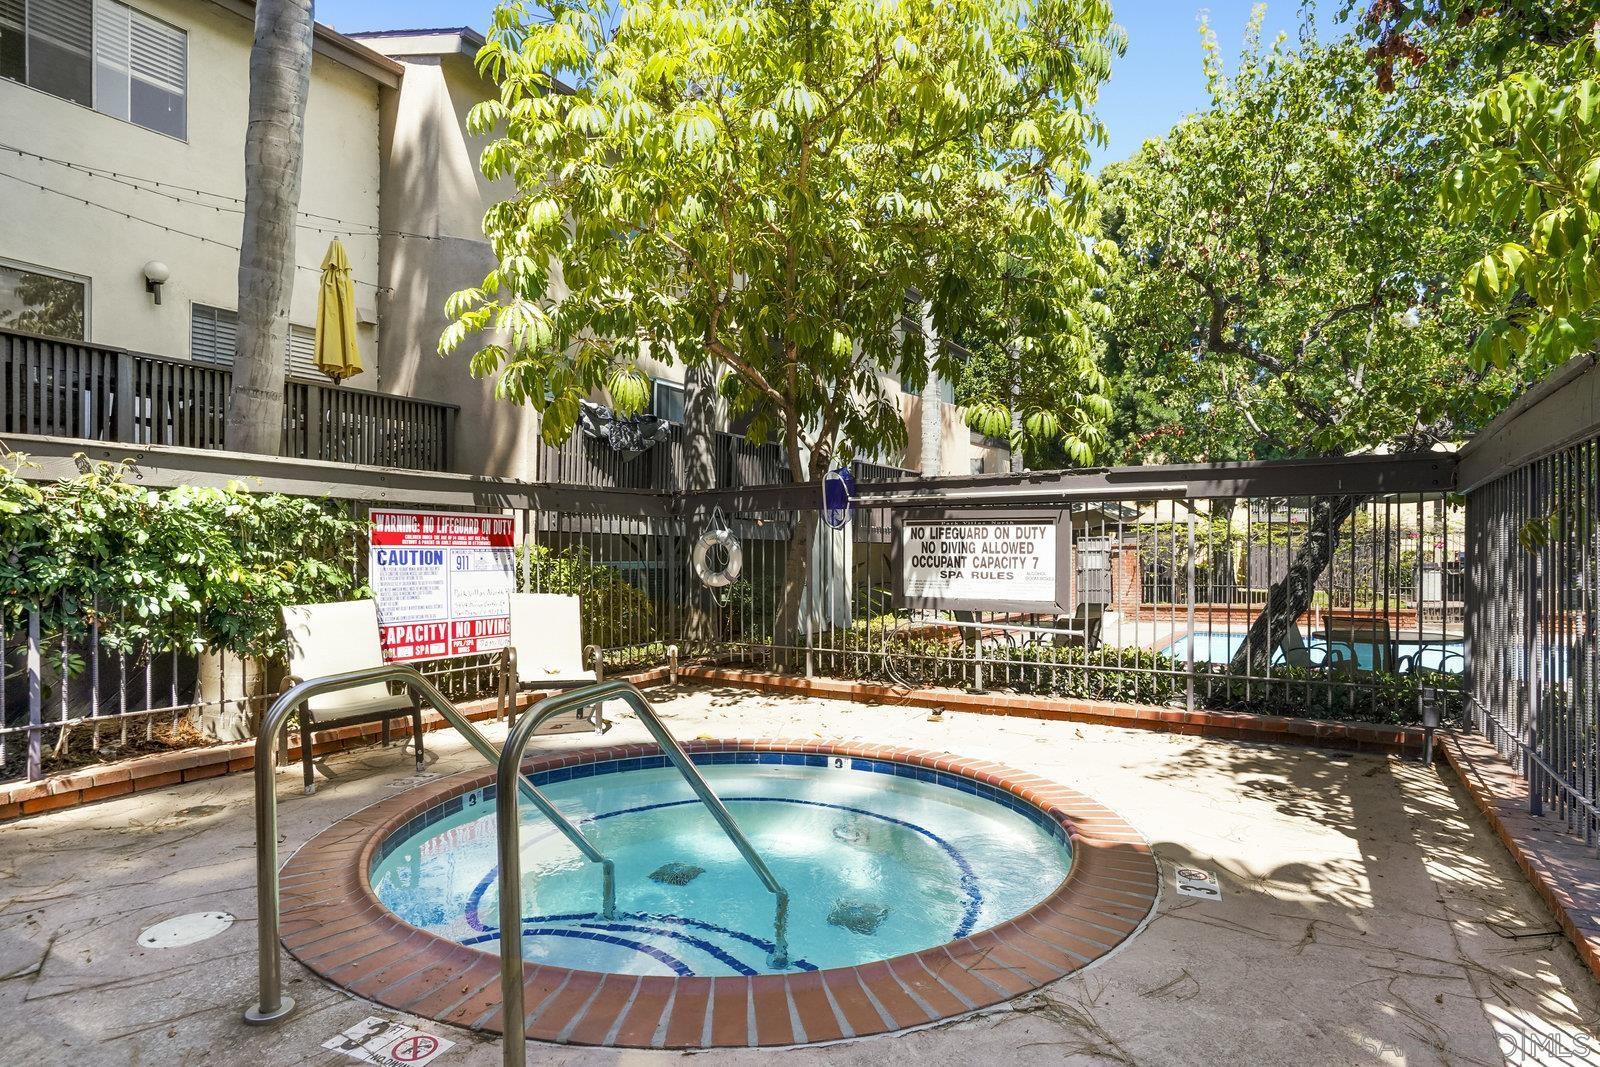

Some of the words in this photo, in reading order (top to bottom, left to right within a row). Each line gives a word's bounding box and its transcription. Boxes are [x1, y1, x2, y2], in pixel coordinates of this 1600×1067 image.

[375, 514, 420, 533] WARNING:
[423, 516, 434, 533] NO
[437, 517, 479, 534] LIFEGUARD
[482, 519, 492, 535] ON
[493, 519, 513, 535] DUTY
[910, 526, 925, 540] NO
[930, 526, 988, 540] LIFEGUARD
[994, 526, 1010, 540] ON
[1016, 526, 1047, 540] DUTY
[922, 541, 935, 555] NO
[940, 541, 976, 555] DIVING
[982, 541, 1035, 555] ALLOWED
[377, 549, 443, 566] CAUTION
[456, 555, 469, 570] 911
[911, 555, 967, 569] OCCUPANT
[972, 556, 1026, 569] CAPACITY
[1032, 557, 1040, 569] 7
[940, 570, 964, 579] SPA
[972, 571, 1014, 580] RULES
[379, 623, 447, 645] CAPACITY
[456, 622, 471, 638] NO
[475, 618, 510, 636] DIVING
[383, 647, 397, 659] OOL
[415, 644, 430, 656] SPA
[835, 758, 843, 768] 3
[469, 793, 477, 806] 3
